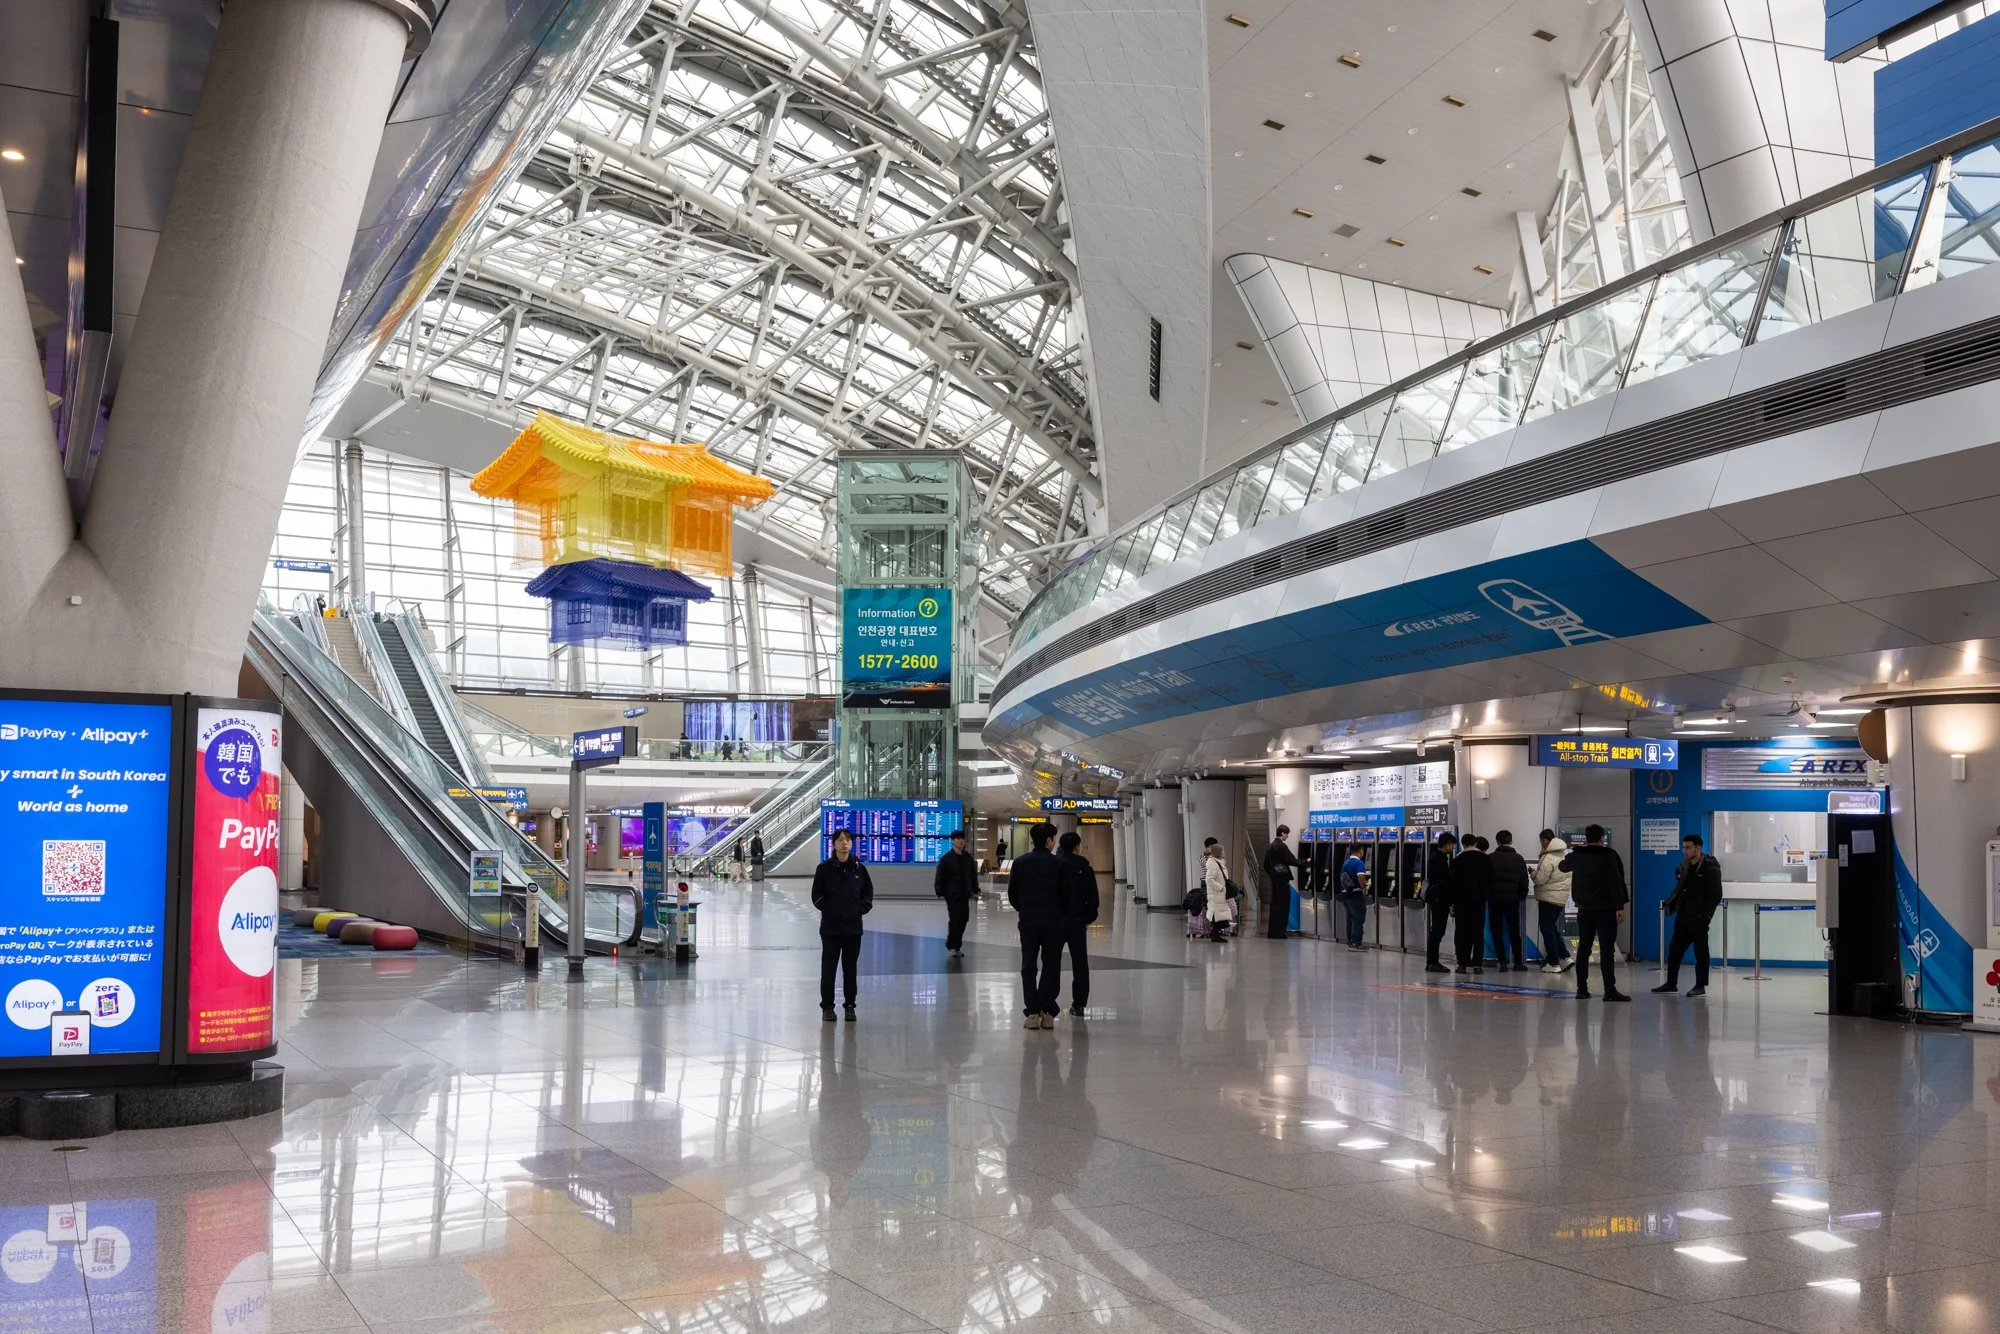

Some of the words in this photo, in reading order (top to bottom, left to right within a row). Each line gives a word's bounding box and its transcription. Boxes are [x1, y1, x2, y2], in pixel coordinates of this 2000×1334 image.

[858, 608, 916, 618] Information
[858, 625, 896, 637] 인천공항
[899, 625, 938, 637] 대표번호
[858, 654, 938, 668] 1577-2600
[20, 727, 66, 740] PayPay
[80, 727, 148, 744] Alipay+
[217, 742, 254, 764] 韓国
[1560, 752, 1589, 764] All-stop
[1590, 753, 1608, 763] Train
[1612, 746, 1642, 759] 일반열차
[1800, 759, 1867, 774] AREX
[12, 768, 58, 780] smart
[61, 768, 75, 780] in
[78, 769, 121, 781] South
[124, 770, 167, 781] Korea
[218, 766, 250, 786] でも
[18, 801, 62, 812] World
[65, 804, 83, 812] as
[86, 802, 128, 813] home
[12, 1000, 56, 1010] Alipay+
